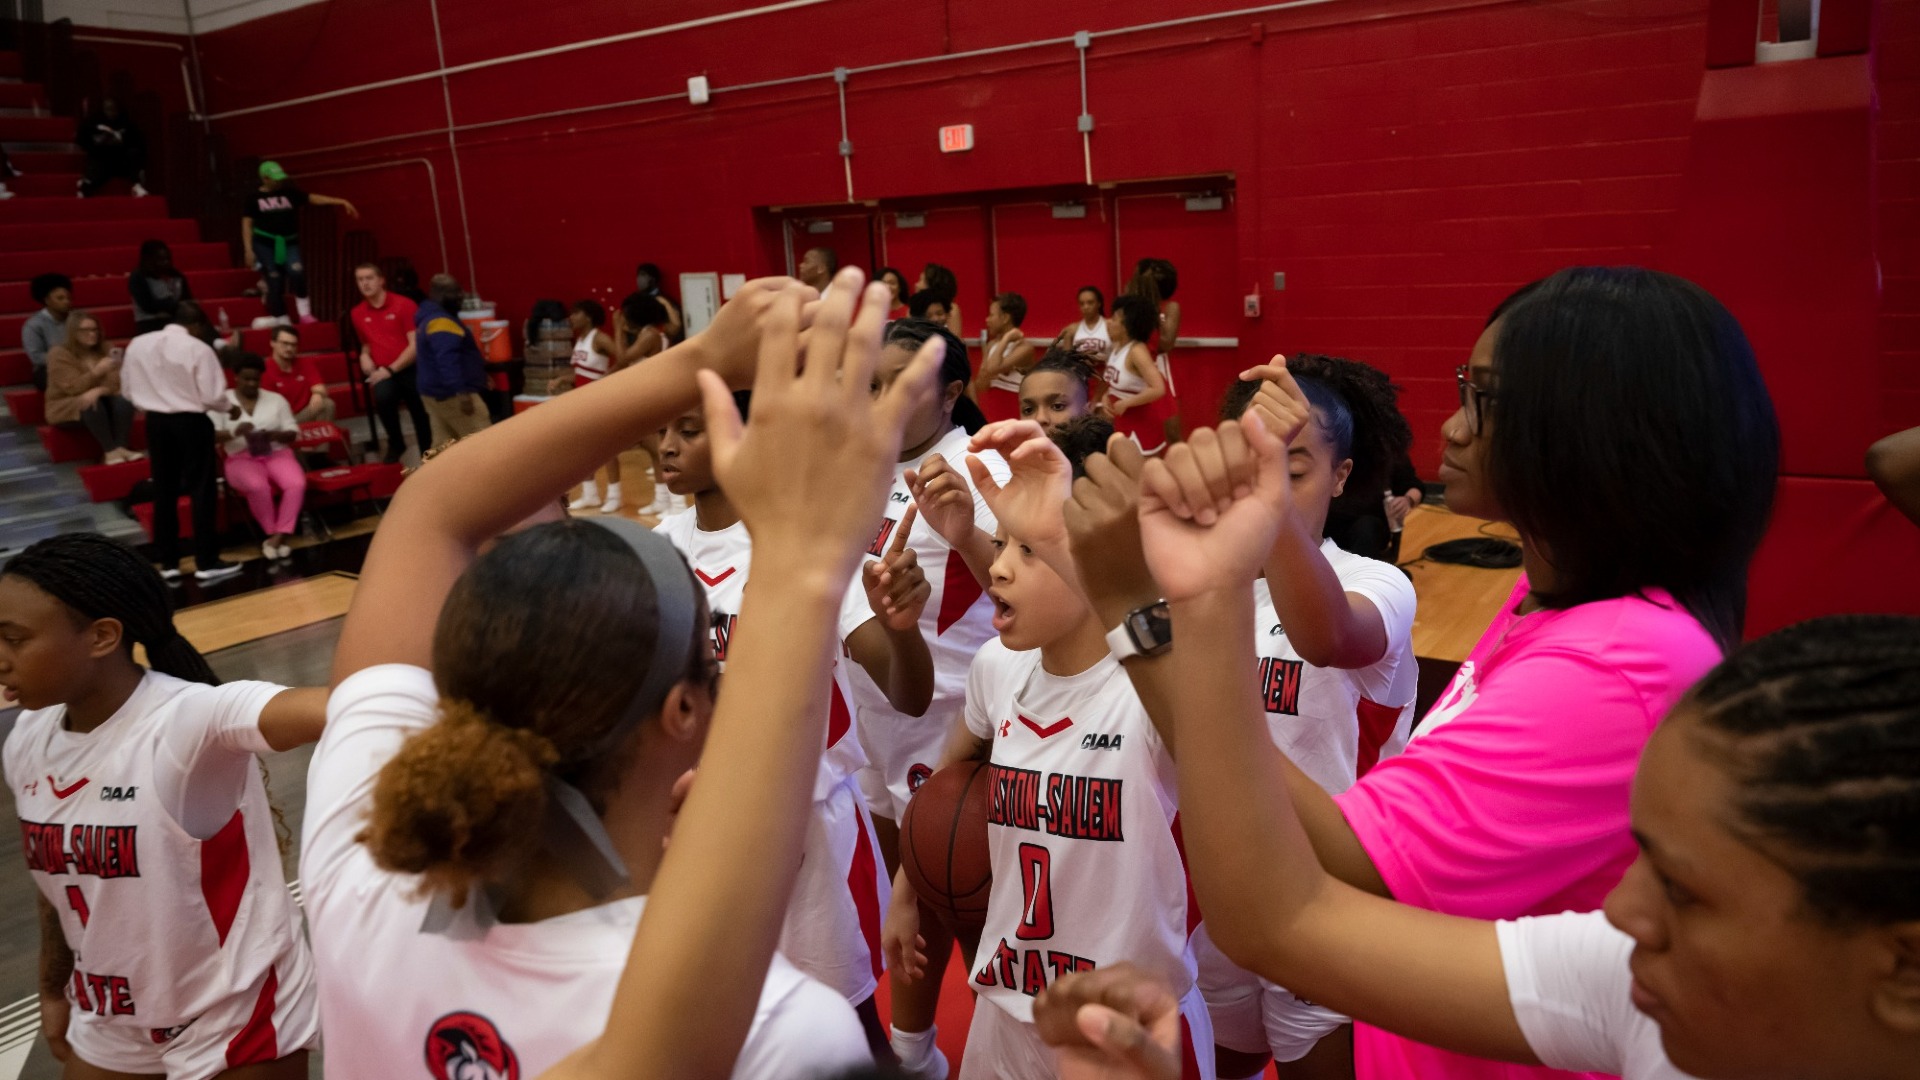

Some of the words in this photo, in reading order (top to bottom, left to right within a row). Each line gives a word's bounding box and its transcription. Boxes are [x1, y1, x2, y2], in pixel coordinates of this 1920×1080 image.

[258, 196, 292, 211] AKA
[1080, 733, 1122, 751] CIAA
[1016, 842, 1055, 940] 0
